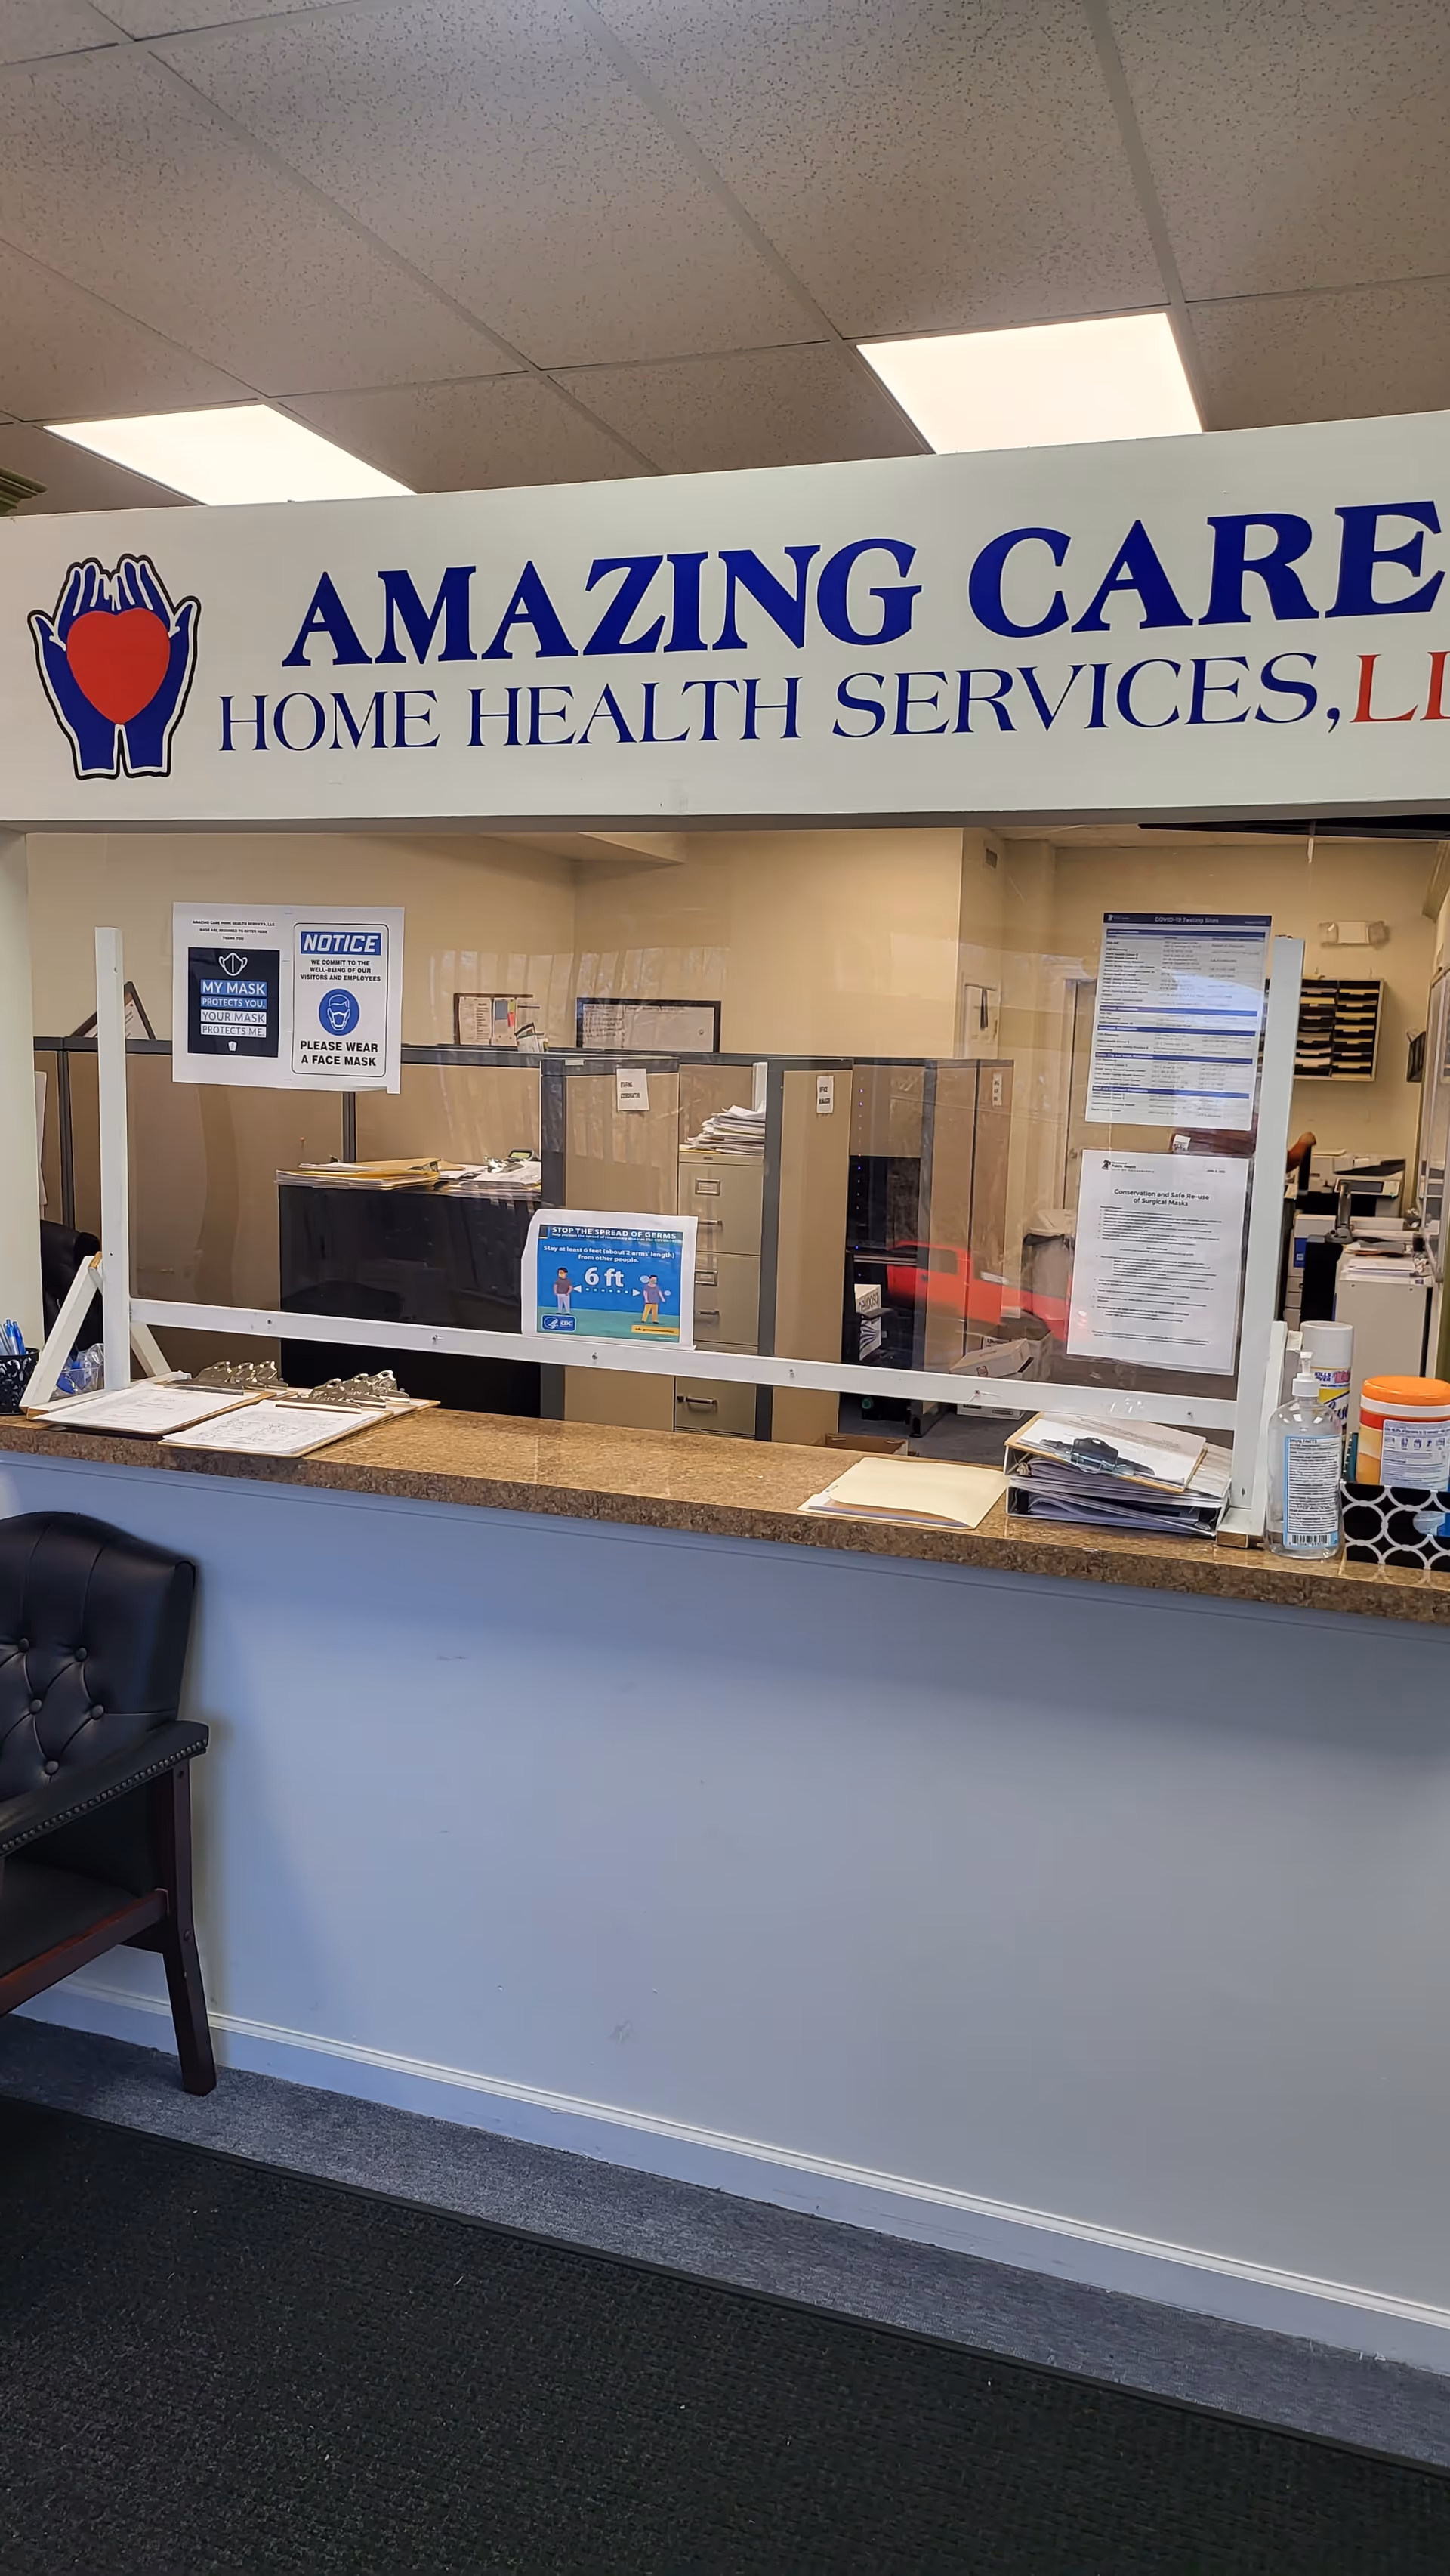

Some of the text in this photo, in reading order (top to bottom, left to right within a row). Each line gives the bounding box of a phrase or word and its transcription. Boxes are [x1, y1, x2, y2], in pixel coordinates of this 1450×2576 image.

[281, 500, 1445, 666] AMAZING CARE
[219, 690, 441, 751] HOME
[467, 675, 801, 746] HEALTH
[303, 934, 379, 953] NOTICE
[202, 981, 265, 995] MY MASK
[202, 997, 266, 1008] PROTECTS YOU.
[202, 1012, 265, 1023] YOUR MASK
[202, 1025, 265, 1036] PROTECTS ME.
[300, 1040, 378, 1052] PLEASE WEAR
[301, 1055, 377, 1067] A FACE MASK
[1114, 1188, 1156, 1197] Conservation
[585, 1267, 625, 1287] 6 ft
